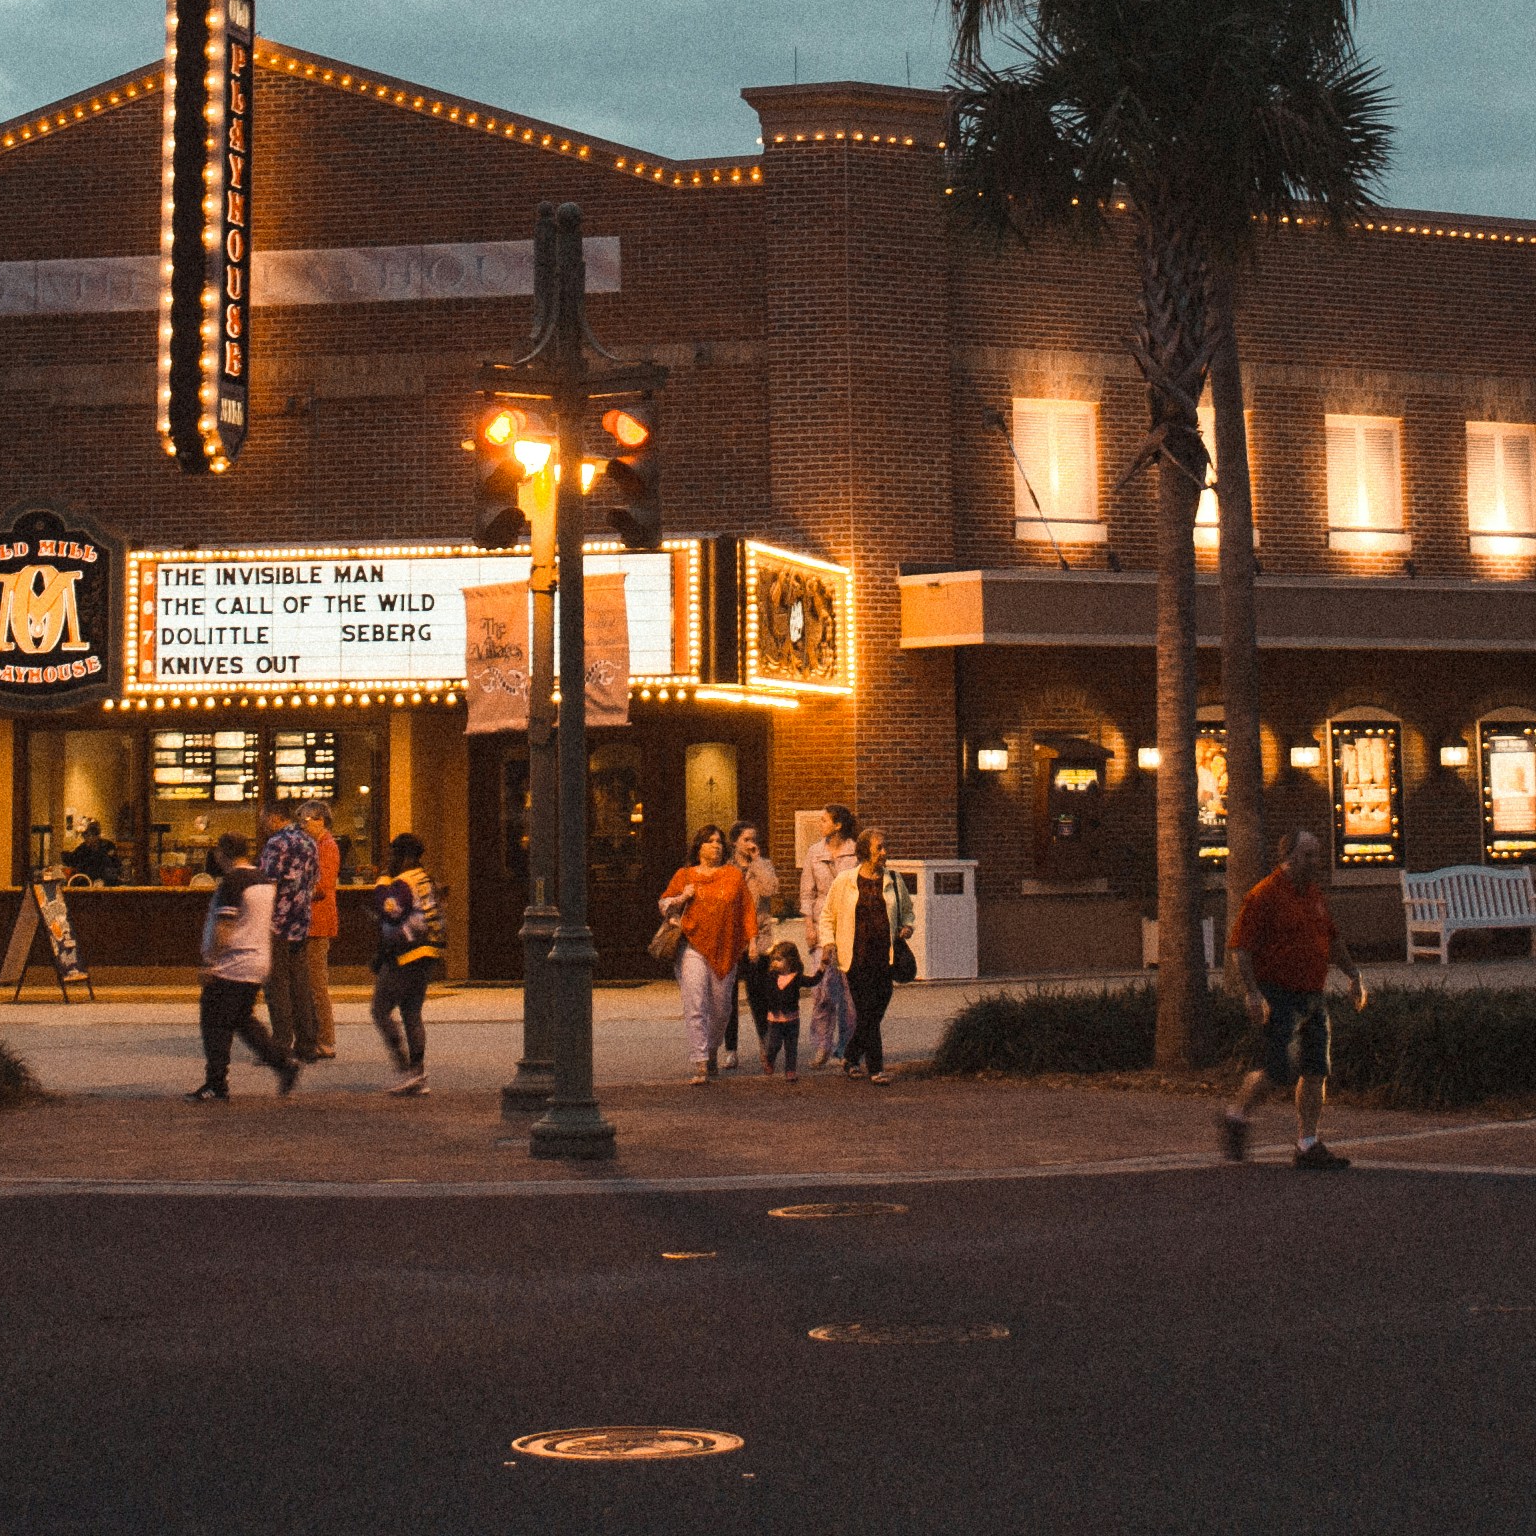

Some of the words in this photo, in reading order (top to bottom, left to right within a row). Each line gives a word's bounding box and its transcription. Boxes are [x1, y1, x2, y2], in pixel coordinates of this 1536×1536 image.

[226, 43, 246, 376] PLAYHOUSE
[38, 539, 98, 562] MILL
[163, 568, 204, 586] THE
[216, 566, 322, 585] INVISIBLE
[334, 564, 384, 583] MAN
[161, 598, 204, 615] THE
[216, 597, 272, 614] CALL
[284, 596, 313, 613] OF
[324, 595, 366, 612] THE
[378, 594, 435, 611] WILD
[142, 631, 152, 645] 7
[162, 626, 269, 645] DOLITTLE
[342, 624, 432, 642] SEBERG
[481, 618, 507, 640] The
[162, 657, 243, 674] KNIVES
[256, 655, 301, 673] OUT
